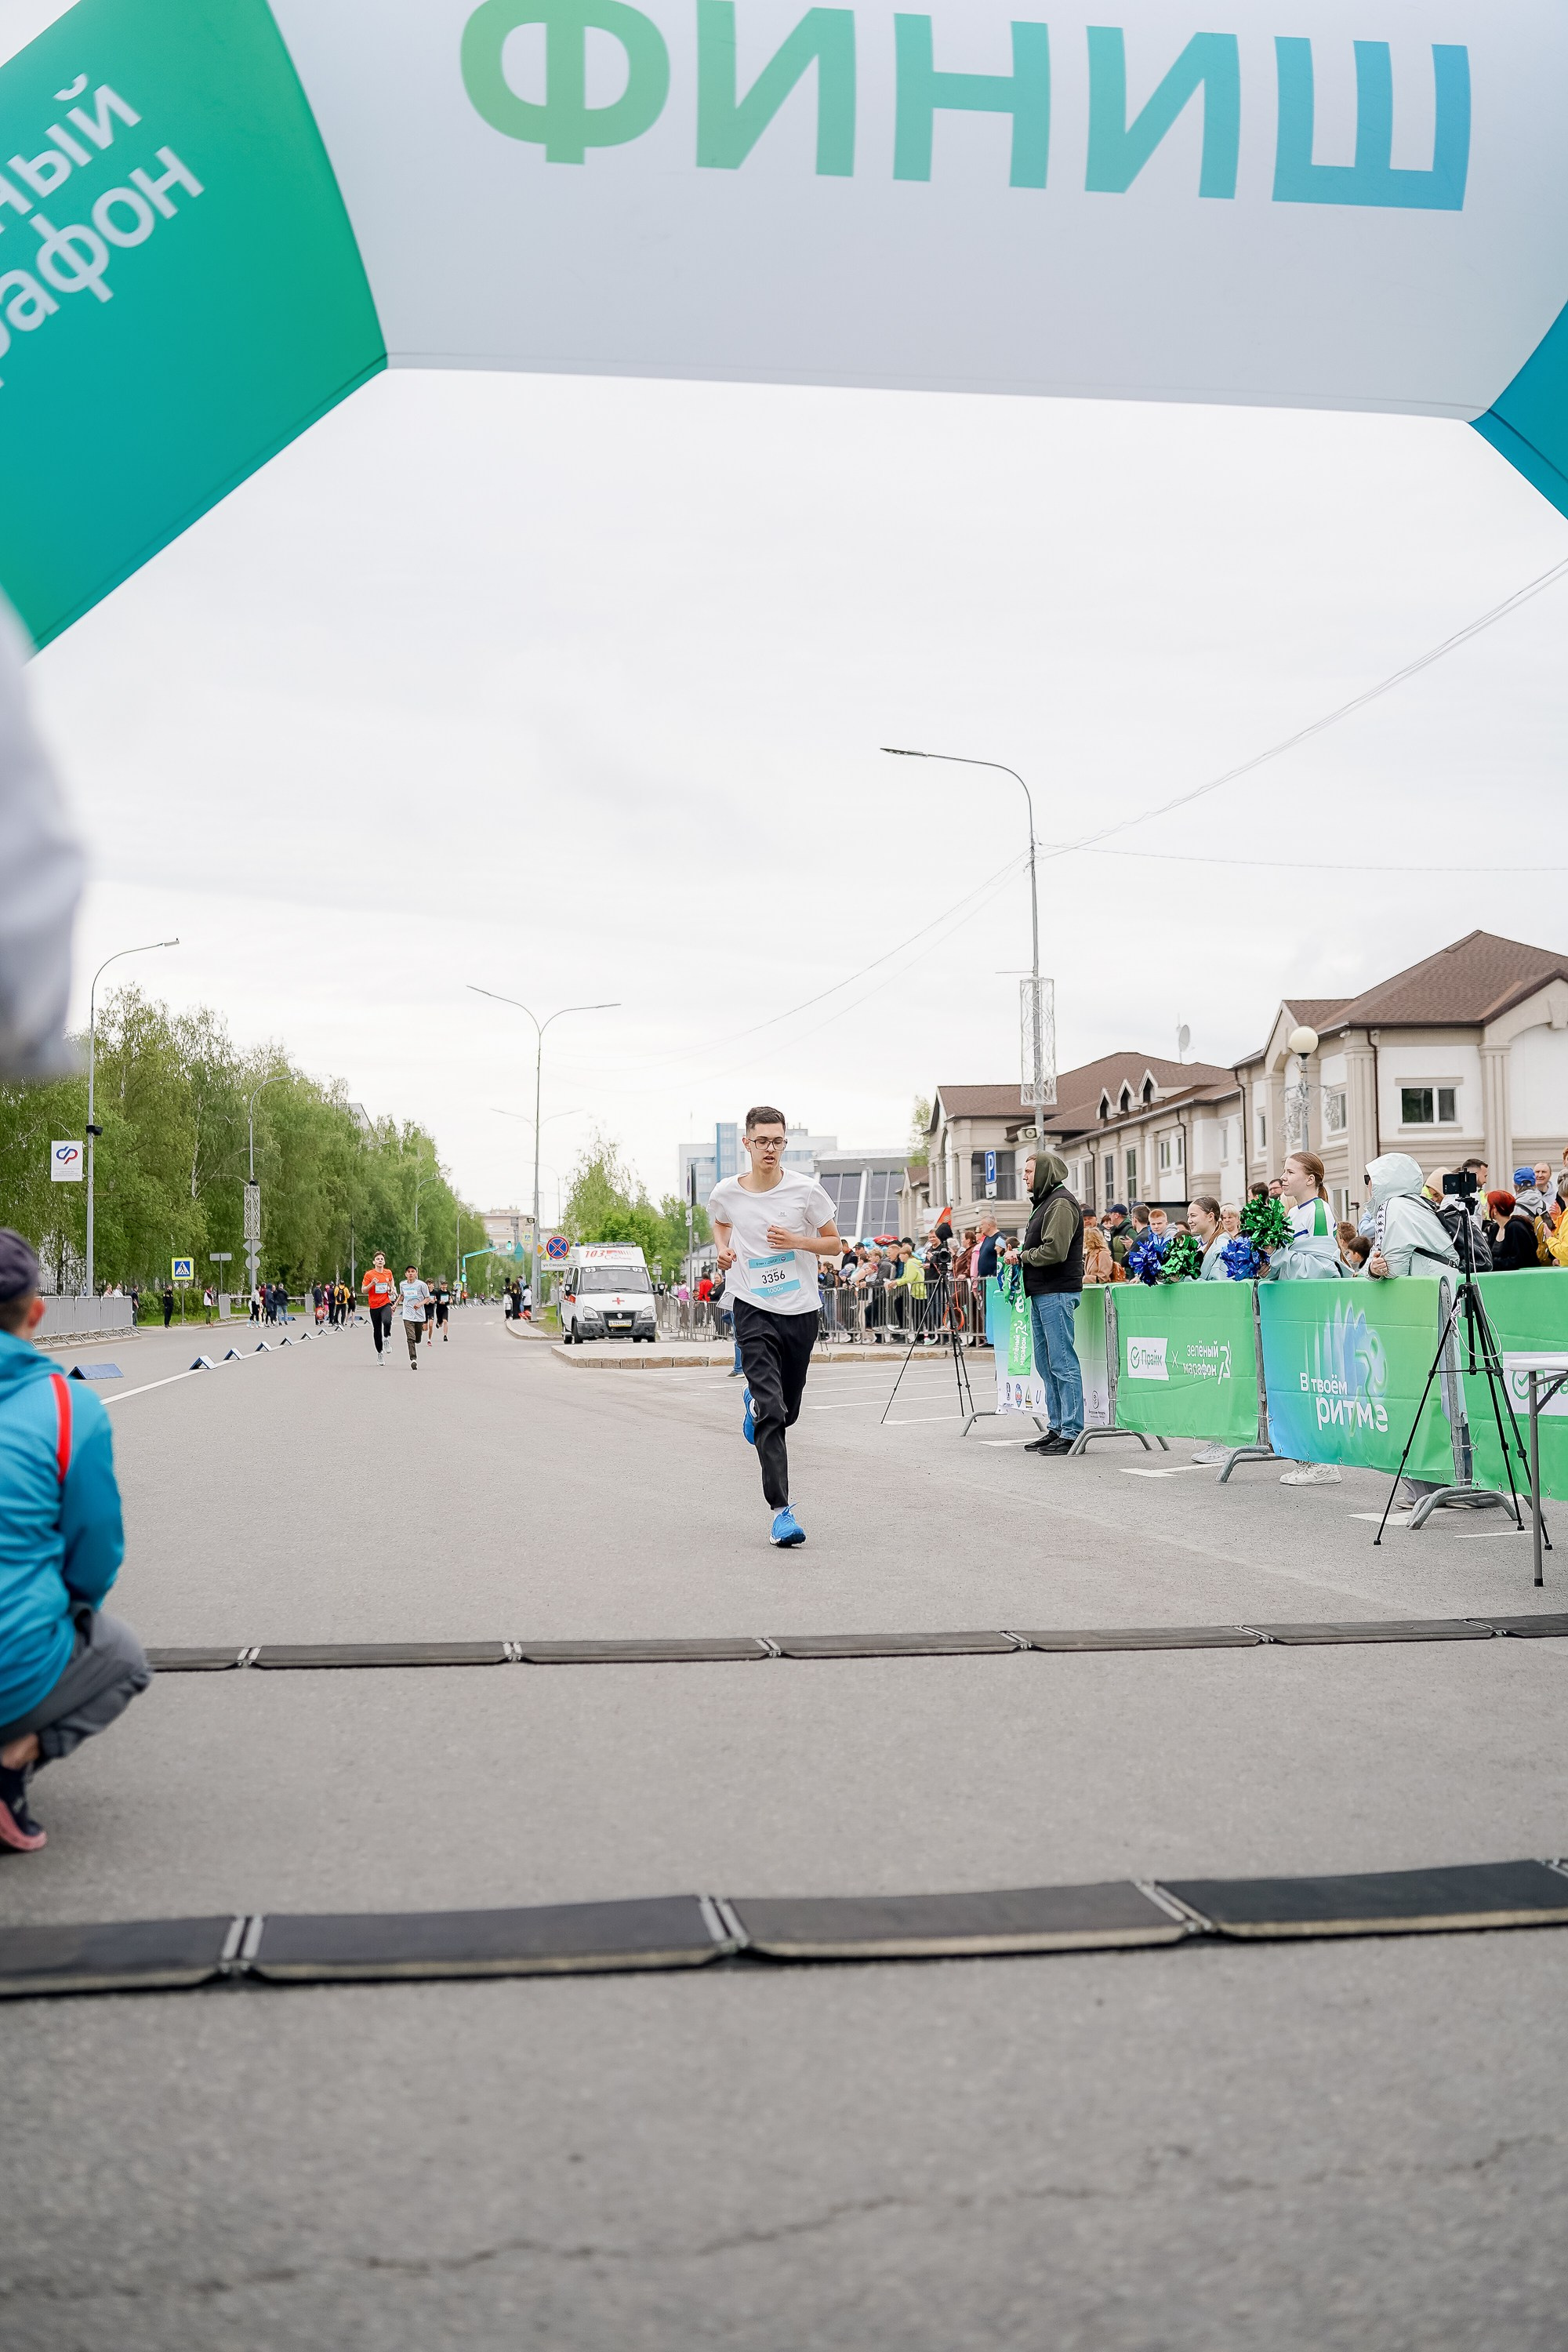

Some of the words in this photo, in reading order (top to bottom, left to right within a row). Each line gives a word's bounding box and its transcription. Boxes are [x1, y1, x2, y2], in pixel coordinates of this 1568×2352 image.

[460, 0, 1471, 211] ФИНИШ
[585, 1250, 605, 1258] 103
[761, 1269, 786, 1284] 3356
[1019, 1337, 1028, 1366] марафон
[1141, 1348, 1163, 1370] Прайм
[1186, 1340, 1219, 1358] зелёный
[1182, 1359, 1218, 1380] марафон
[1299, 1372, 1309, 1392] В
[1310, 1374, 1348, 1396] твоём
[1316, 1396, 1388, 1433] ритме
